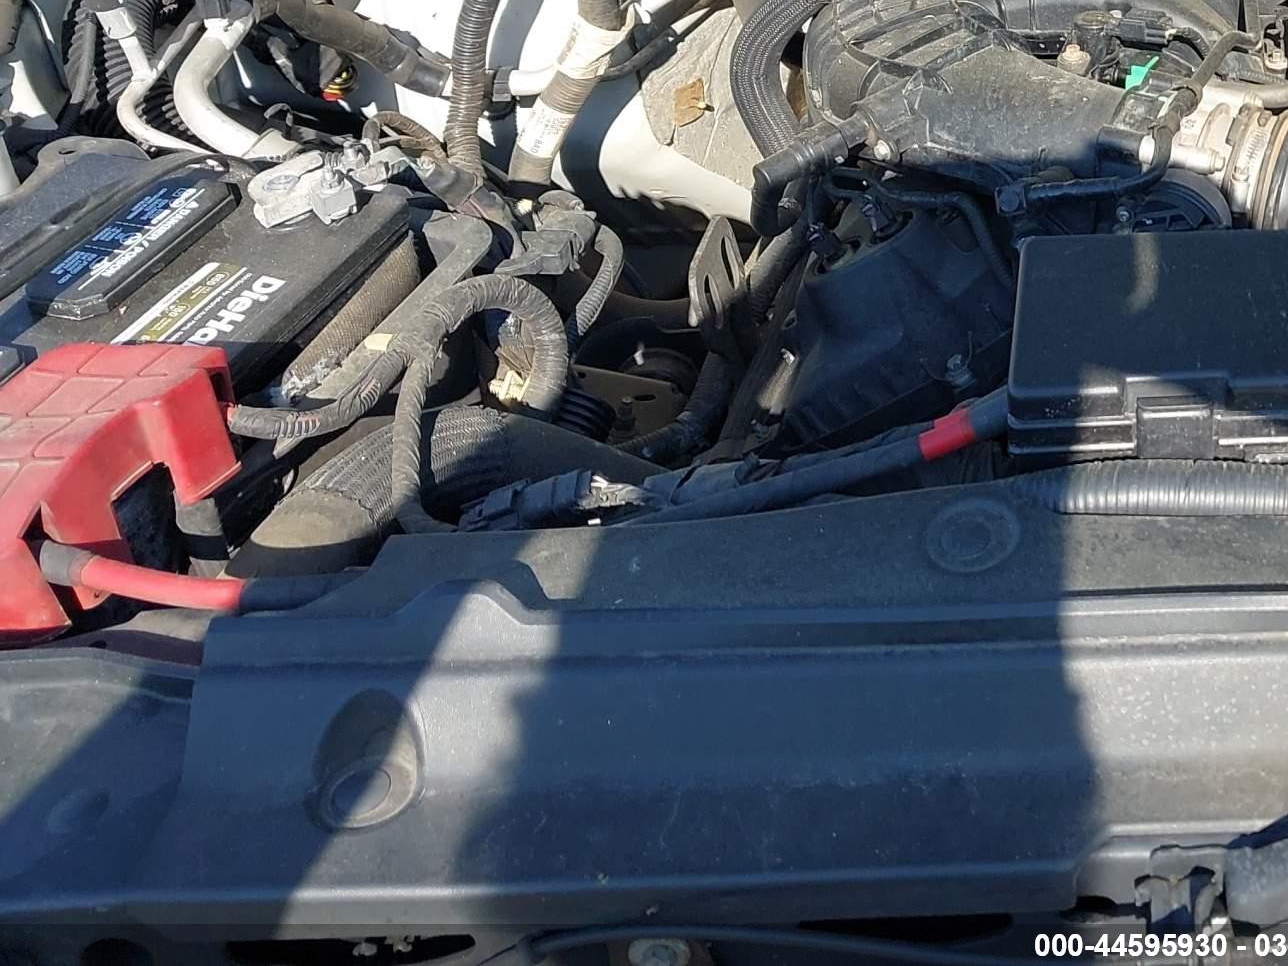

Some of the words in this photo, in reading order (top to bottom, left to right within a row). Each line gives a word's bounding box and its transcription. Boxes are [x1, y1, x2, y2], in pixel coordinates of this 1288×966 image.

[146, 209, 192, 241] DANGER
[101, 247, 144, 277] POISON
[185, 275, 287, 346] DieHa
